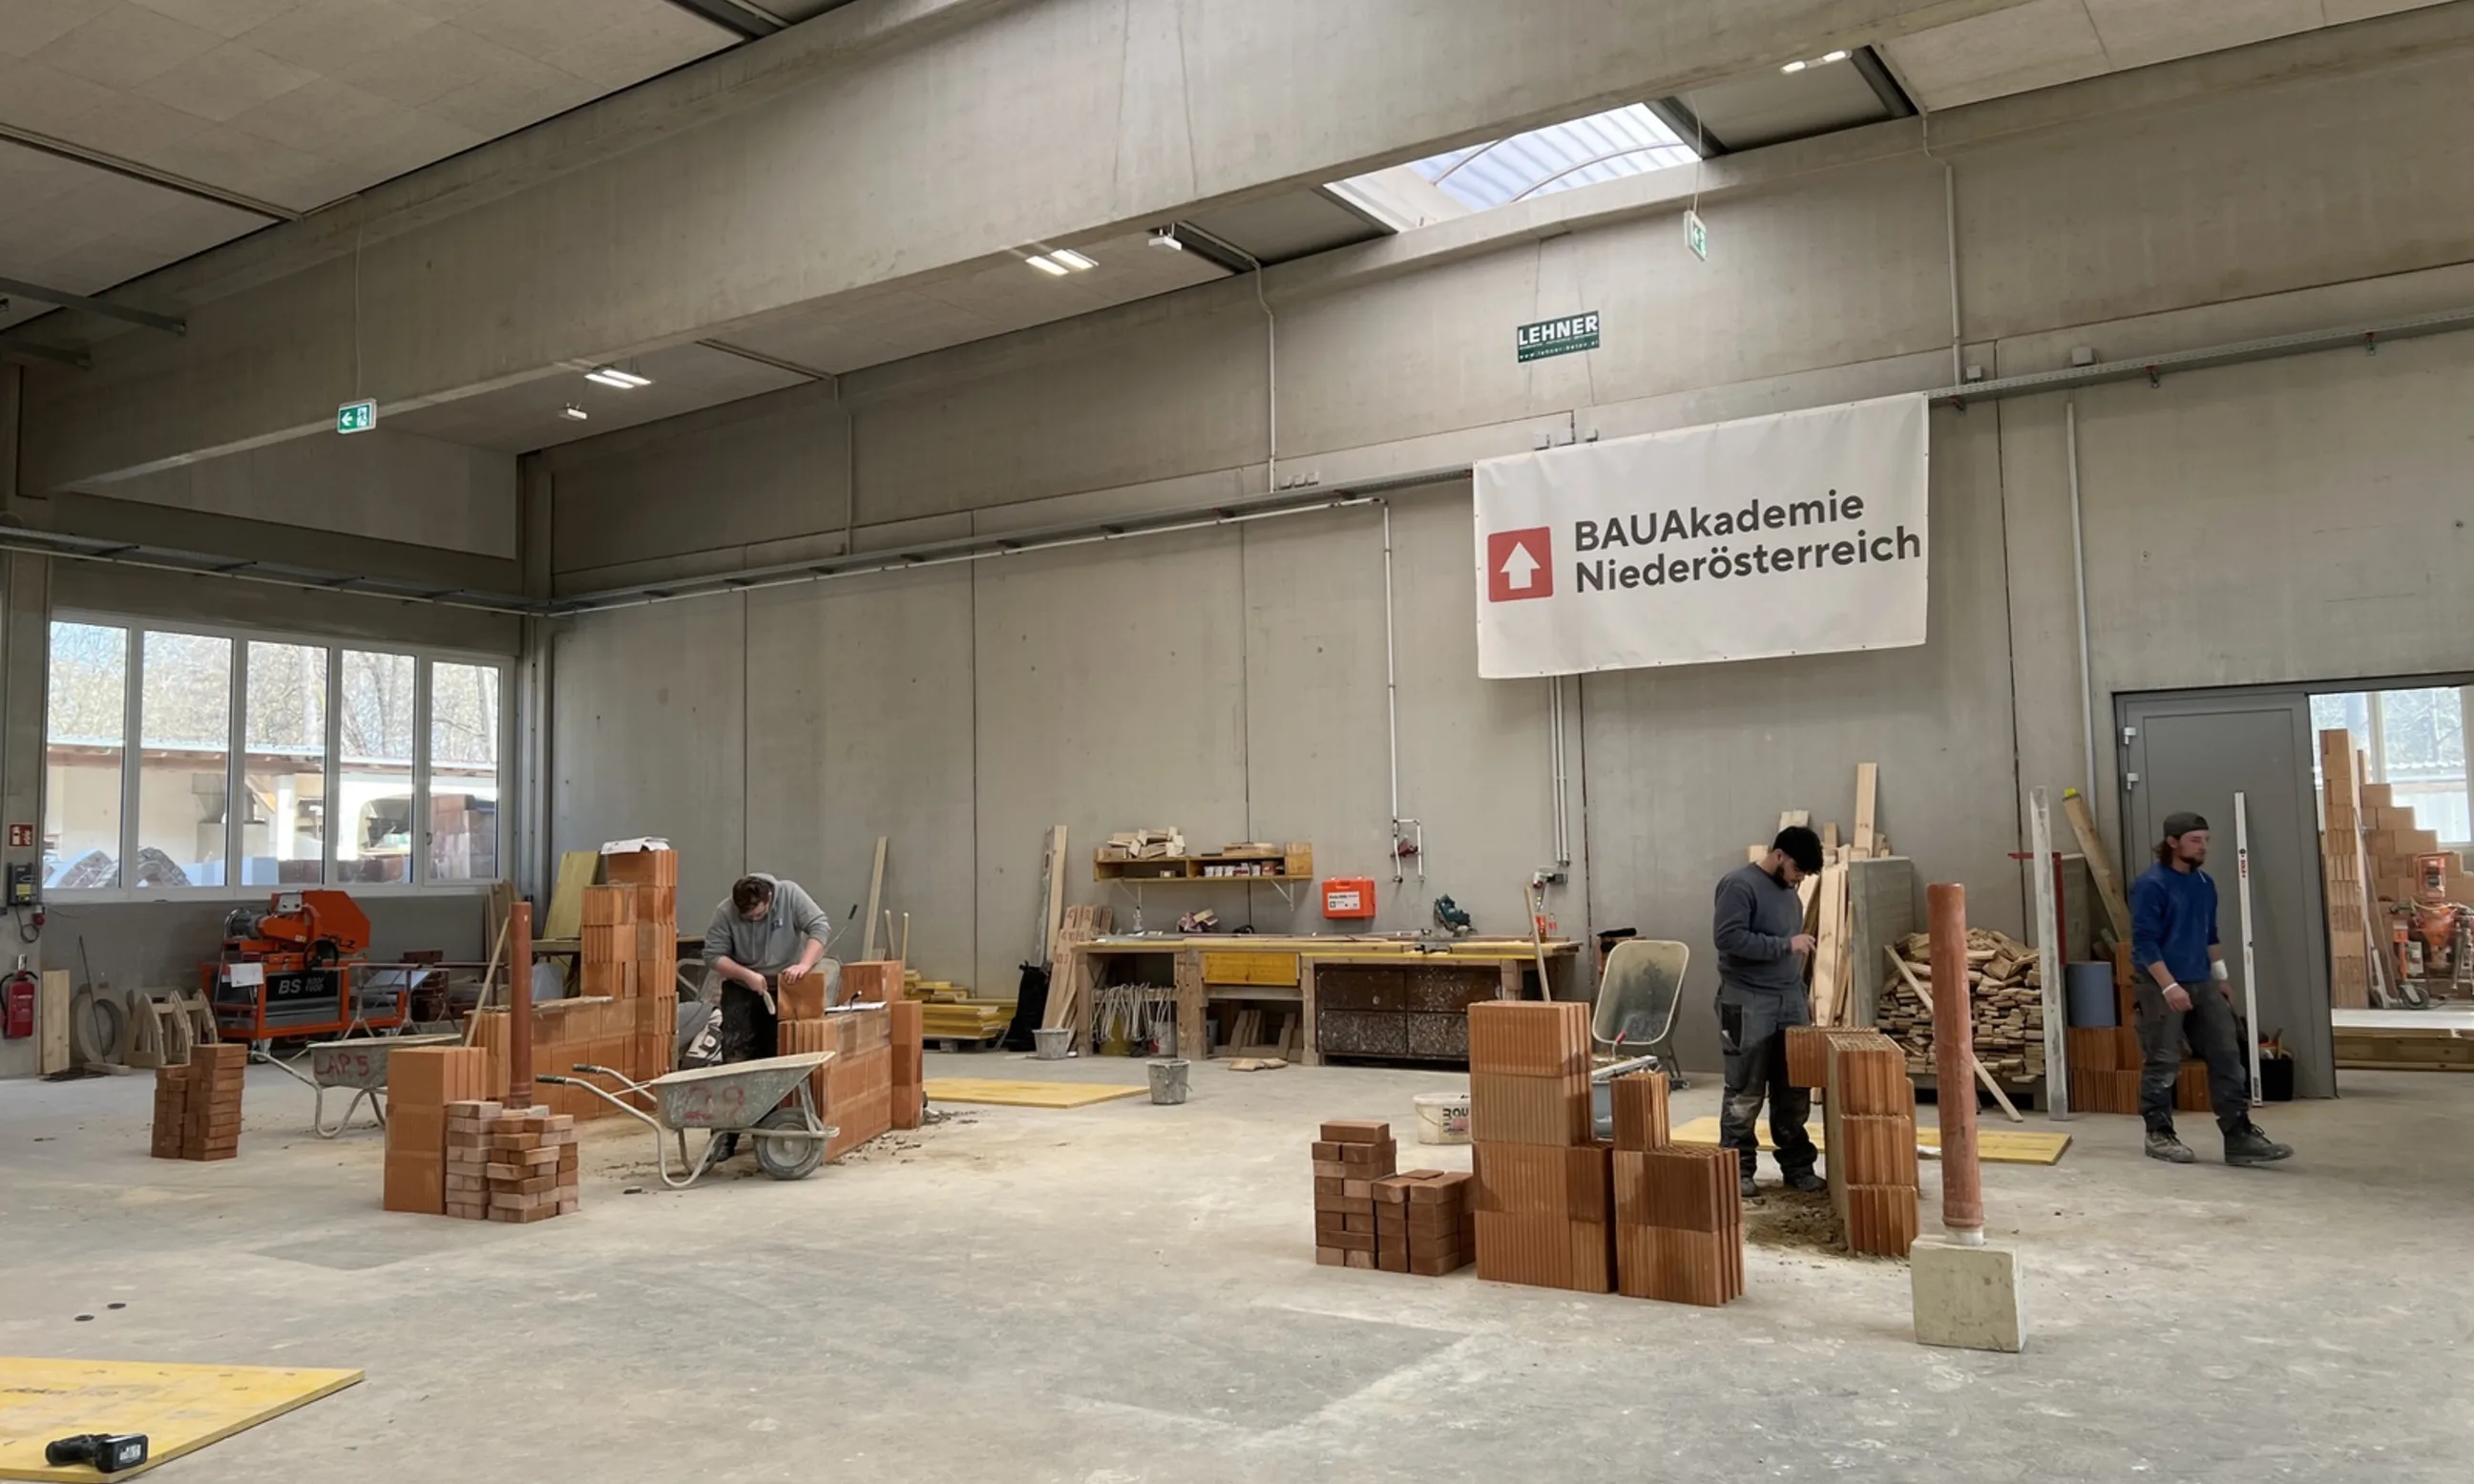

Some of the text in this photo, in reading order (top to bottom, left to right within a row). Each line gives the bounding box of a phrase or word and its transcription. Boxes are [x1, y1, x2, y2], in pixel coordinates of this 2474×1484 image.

[1519, 315, 1598, 345] LEHNER
[1576, 489, 1864, 552] BAUAkademie
[1576, 526, 1920, 593] Niederösterreich
[278, 978, 302, 994] BS
